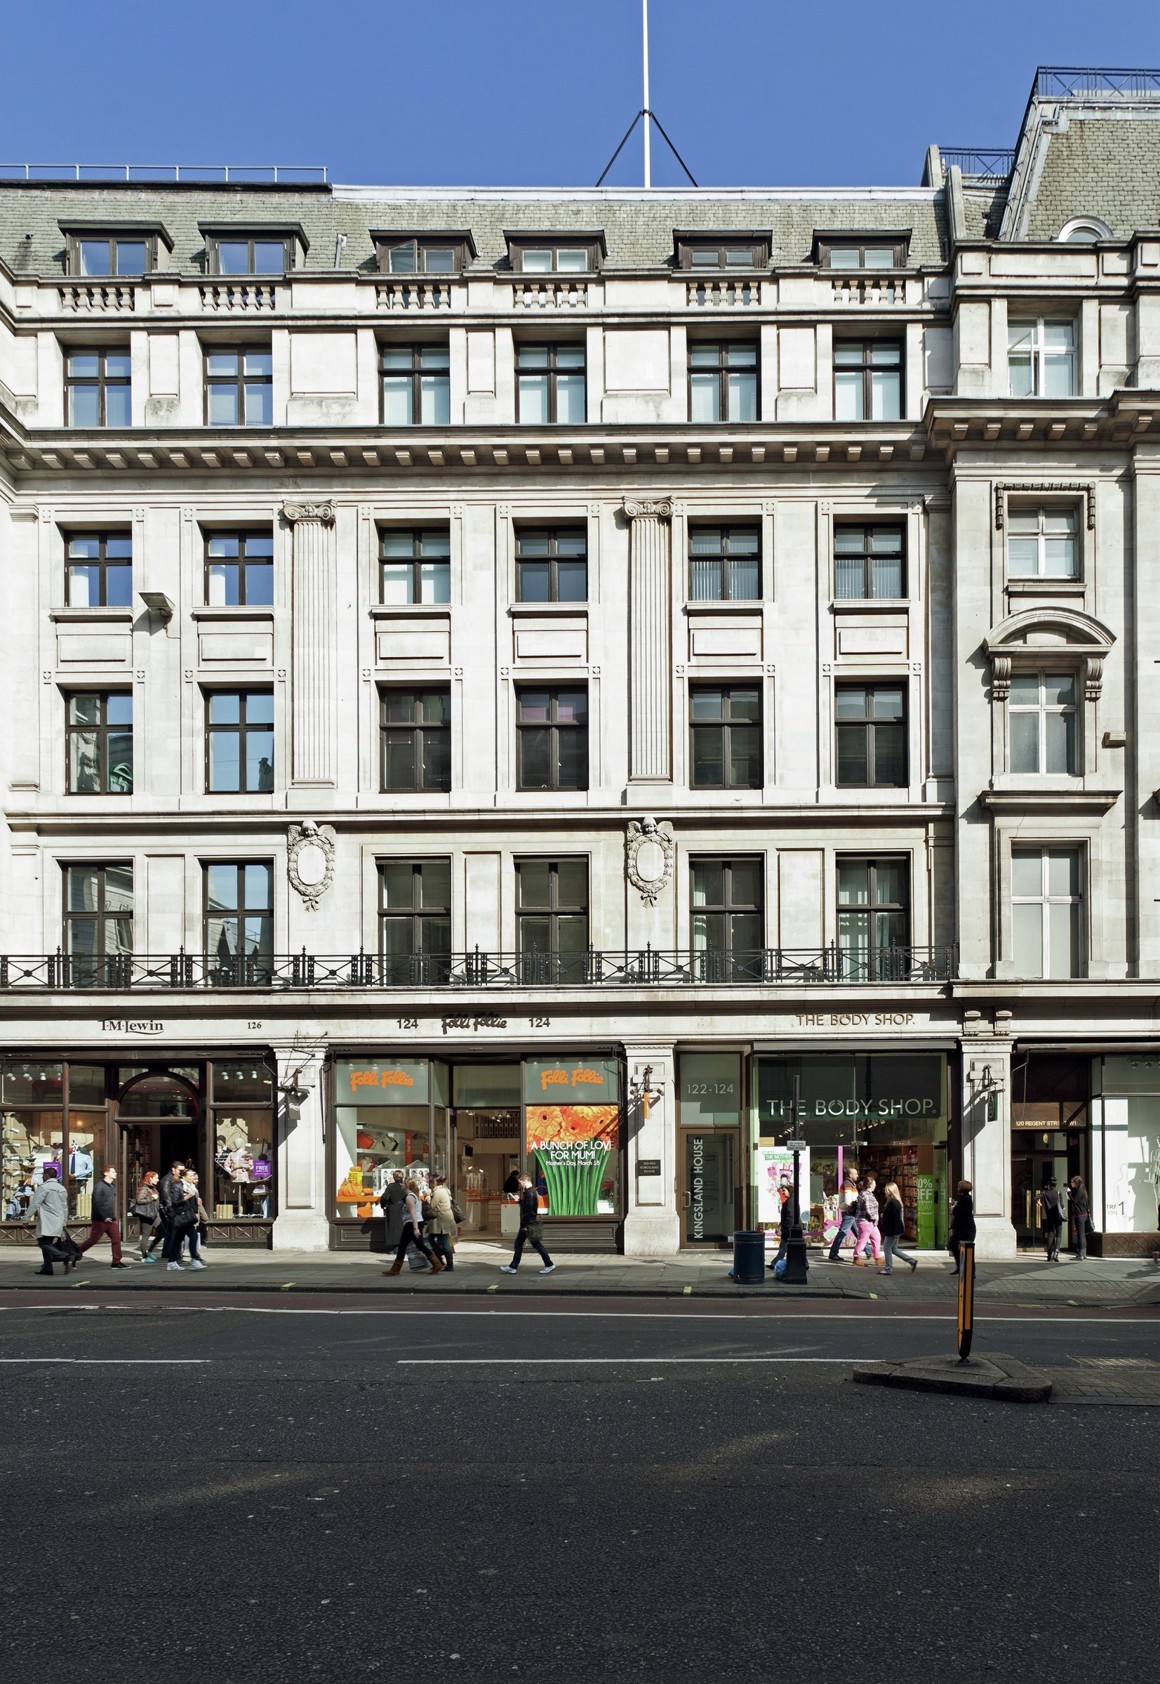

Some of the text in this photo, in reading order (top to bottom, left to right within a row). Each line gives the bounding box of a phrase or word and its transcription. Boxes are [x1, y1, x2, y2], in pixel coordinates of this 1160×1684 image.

[397, 1019, 418, 1029] 124
[529, 1018, 550, 1027] 124
[796, 1014, 824, 1026] THE
[830, 1013, 870, 1025] BODY
[351, 1070, 414, 1092] Folli Follie
[541, 1068, 603, 1090] Folli Follie
[687, 1084, 734, 1094] 122-124
[766, 1099, 806, 1116] THE
[815, 1099, 872, 1115] BODY
[531, 1140, 615, 1151] A BUNCH OF LOVE
[551, 1151, 569, 1160] FOR
[693, 1138, 704, 1239] KINGSLAND HOUSE
